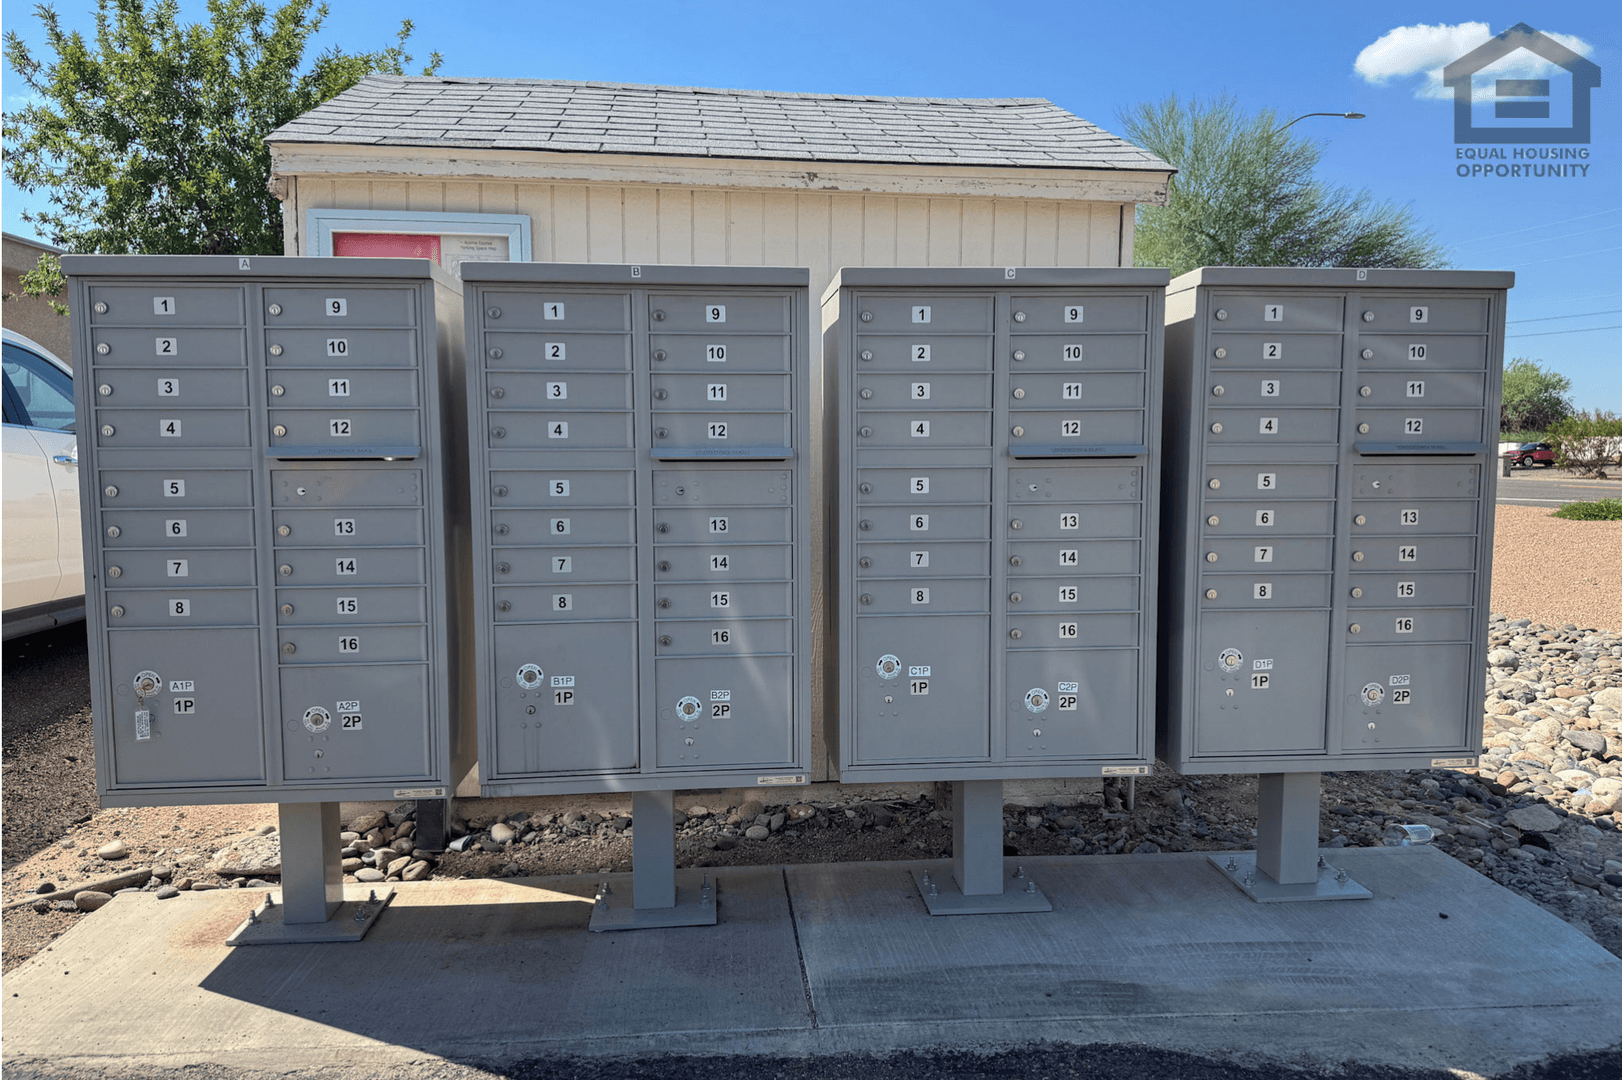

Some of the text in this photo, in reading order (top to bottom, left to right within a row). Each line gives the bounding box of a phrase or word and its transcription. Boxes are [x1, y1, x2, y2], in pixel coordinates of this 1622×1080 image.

[242, 259, 249, 269] A
[633, 267, 640, 276] B
[1007, 269, 1014, 278] C
[1359, 270, 1366, 279] D
[161, 299, 168, 312] 1
[331, 300, 341, 314] 9
[551, 305, 558, 318] 1
[711, 307, 720, 321] 9
[918, 308, 925, 321] 1
[1069, 308, 1078, 321] 9
[1271, 307, 1277, 319] 1
[1415, 308, 1423, 321] 9
[162, 339, 171, 353] 2
[328, 340, 346, 354] 10
[551, 344, 560, 358] 2
[917, 346, 925, 359] 2
[1065, 346, 1081, 359] 10
[1268, 344, 1277, 357] 2
[1410, 346, 1425, 358] 10
[708, 346, 725, 360] 10
[164, 381, 173, 394] 3
[332, 381, 347, 394] 11
[553, 384, 561, 397] 3
[710, 385, 724, 398] 11
[917, 385, 925, 398] 3
[1066, 384, 1079, 397] 11
[1266, 382, 1275, 395] 3
[1409, 383, 1422, 395] 11
[166, 421, 176, 435] 4
[332, 421, 350, 434] 12
[553, 423, 563, 436] 4
[709, 424, 726, 437] 12
[916, 422, 925, 435] 4
[1063, 422, 1079, 434] 12
[1264, 419, 1273, 431] 4
[1406, 420, 1422, 432] 12
[916, 479, 924, 492] 5
[1262, 475, 1271, 488] 5
[170, 482, 179, 495] 5
[555, 482, 564, 495] 5
[915, 516, 924, 529] 6
[1061, 515, 1077, 528] 13
[1261, 512, 1269, 524] 6
[1402, 512, 1417, 523] 13
[171, 521, 181, 535] 6
[336, 521, 354, 534] 13
[556, 520, 565, 533] 6
[711, 519, 727, 531] 13
[915, 553, 924, 565] 7
[1061, 551, 1077, 563] 14
[1260, 548, 1268, 560] 7
[1400, 548, 1415, 560] 14
[172, 562, 182, 575] 7
[337, 560, 355, 573] 14
[557, 558, 566, 571] 7
[712, 556, 728, 569] 14
[916, 590, 924, 602] 8
[1060, 588, 1076, 601] 15
[1259, 585, 1267, 597] 8
[1399, 584, 1414, 596] 15
[338, 599, 356, 613] 15
[558, 596, 567, 609] 8
[712, 594, 728, 606] 15
[175, 601, 184, 614] 8
[1060, 624, 1076, 636] 16
[1397, 619, 1412, 631] 16
[713, 630, 729, 643] 16
[340, 638, 358, 651] 16
[523, 664, 539, 672] OPEN
[1255, 659, 1273, 669] D1P
[141, 671, 156, 679] OPEN
[910, 666, 929, 676] C1P
[172, 681, 192, 690] A1P
[553, 677, 573, 686] B1P
[1252, 675, 1269, 687] 1P
[1391, 675, 1410, 685] D2P
[911, 681, 928, 694] 1P
[1058, 682, 1078, 692] C2P
[555, 691, 573, 704] 1P
[683, 696, 697, 704] OPEN
[711, 691, 730, 700] B2P
[1059, 696, 1077, 708] 2P
[1393, 690, 1410, 702] 2P
[175, 699, 194, 712] 1P
[311, 707, 325, 715] OPEN
[338, 701, 358, 711] A2P
[712, 704, 730, 717] 2P
[342, 715, 362, 728] 2P
